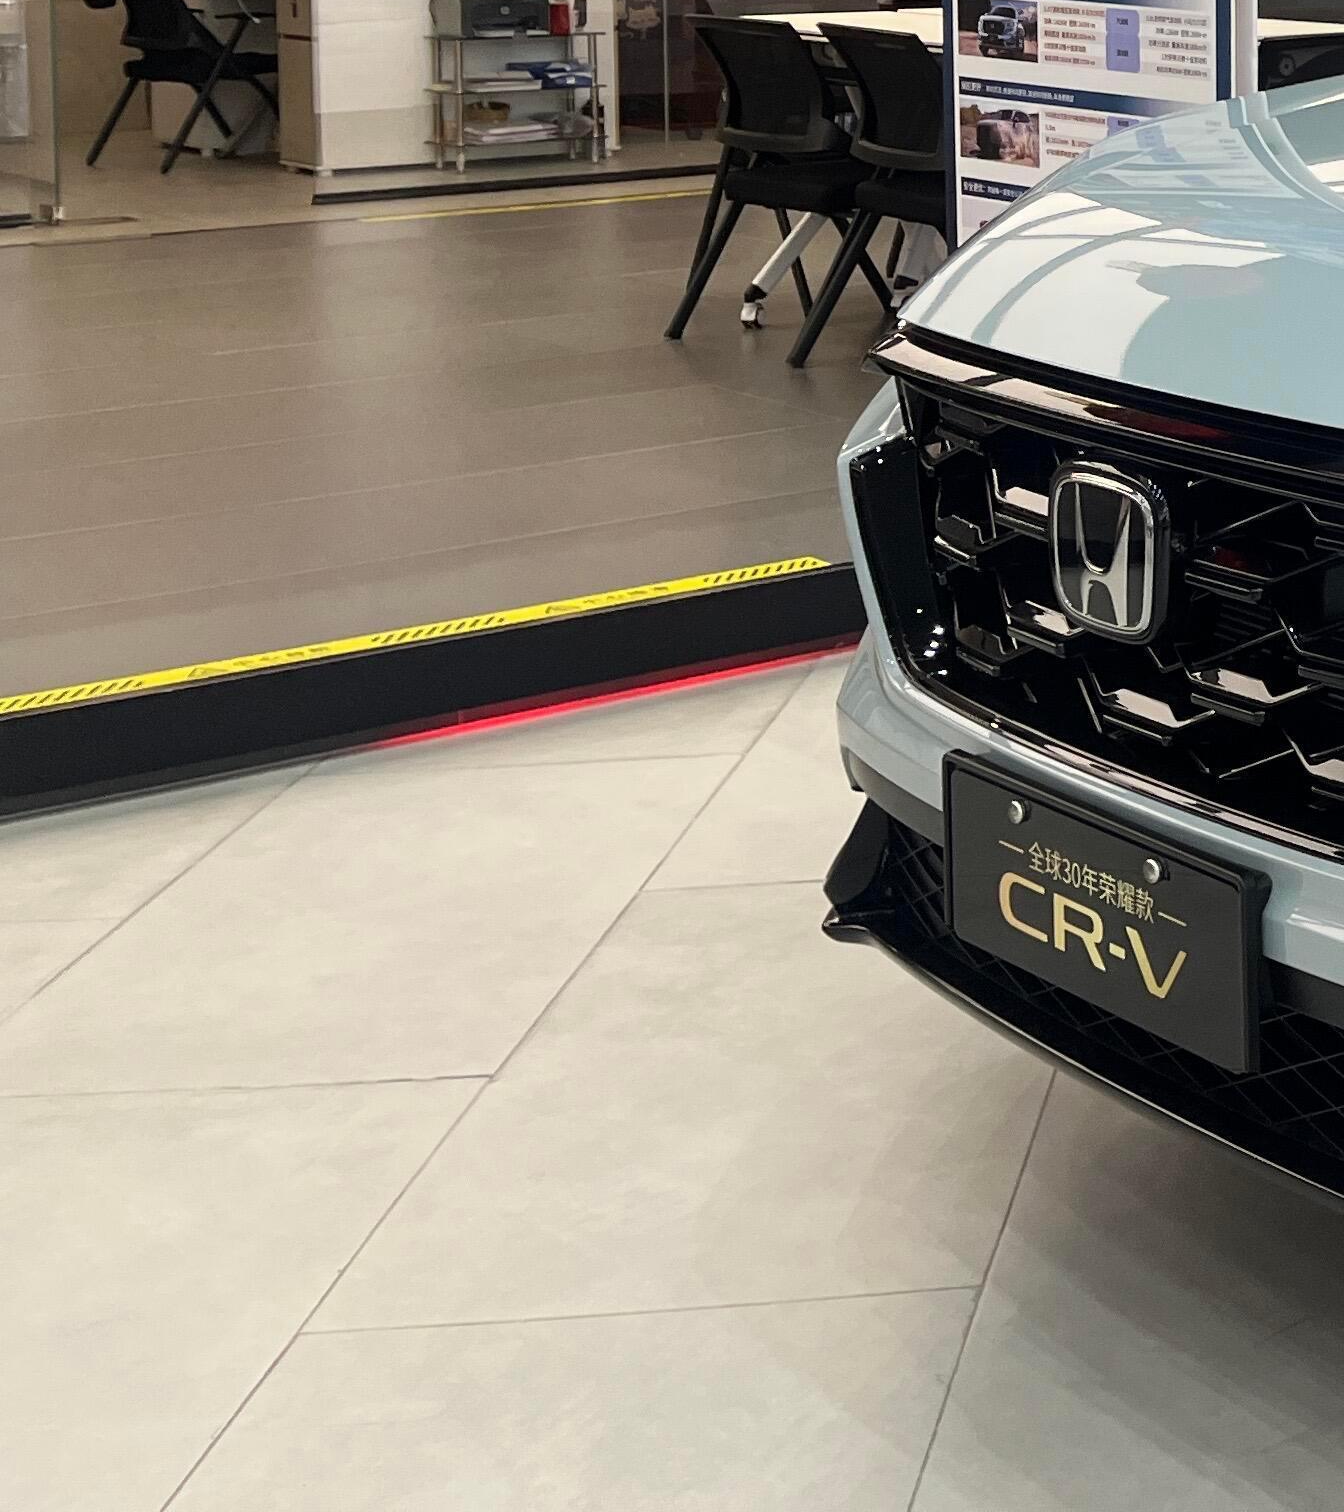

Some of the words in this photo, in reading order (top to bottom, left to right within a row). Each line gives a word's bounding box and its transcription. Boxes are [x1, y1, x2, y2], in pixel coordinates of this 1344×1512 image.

[998, 871, 1188, 999] CR-V
[1028, 841, 1156, 924] 全球30年荣耀款
